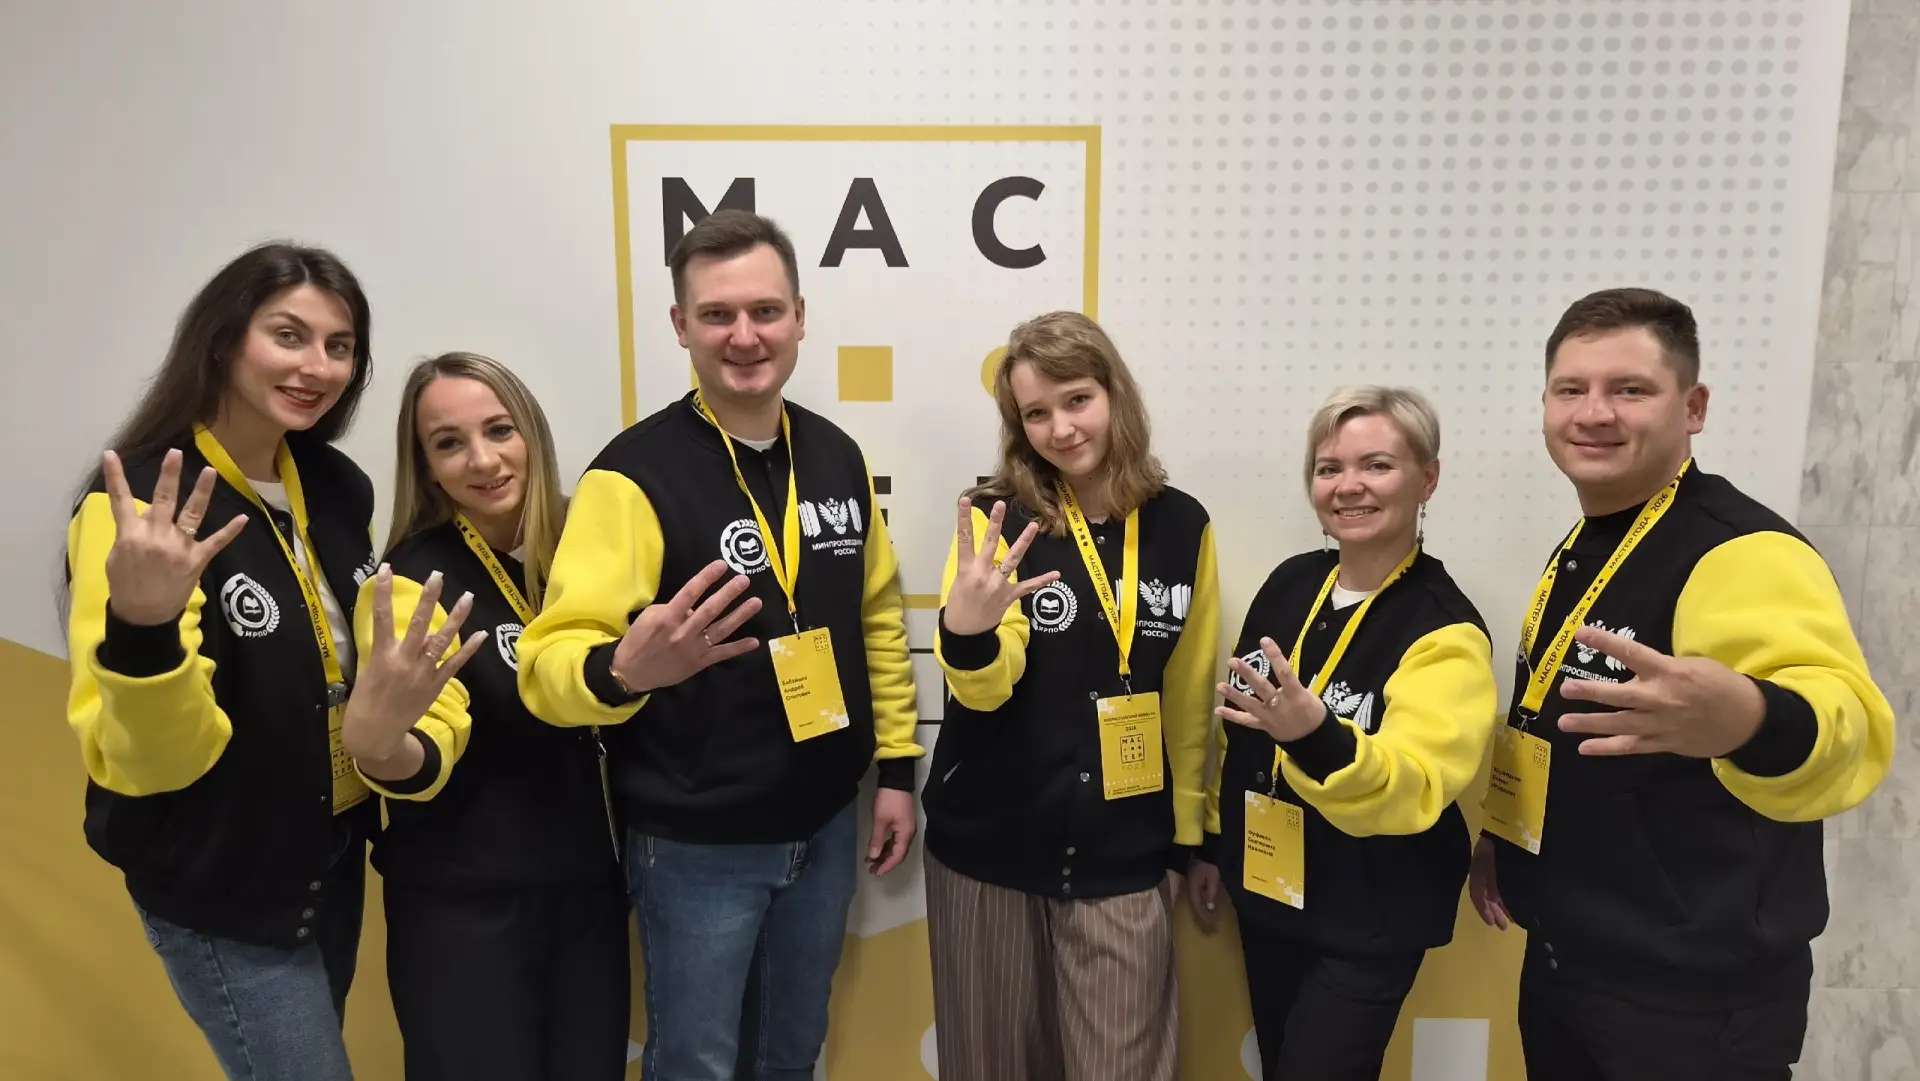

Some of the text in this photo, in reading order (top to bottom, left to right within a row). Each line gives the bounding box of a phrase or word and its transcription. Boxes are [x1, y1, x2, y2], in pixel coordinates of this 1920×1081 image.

[1609, 493, 1669, 569] МАСТЕР ГОДА 2026
[476, 542, 526, 612] МАСТЕР ГОДА 2026
[746, 566, 766, 575] ИРПО
[1088, 555, 1118, 623] МАСТЕР ГОДА 2026
[245, 629, 268, 638] ИРПО
[303, 578, 331, 658] МАСТЕР ГОДА 2026
[1142, 629, 1169, 639] РОССИИ
[1524, 589, 1548, 643] МАСТЕР ГОДА
[1539, 606, 1586, 684] МАСТЕР ГОДА 2026
